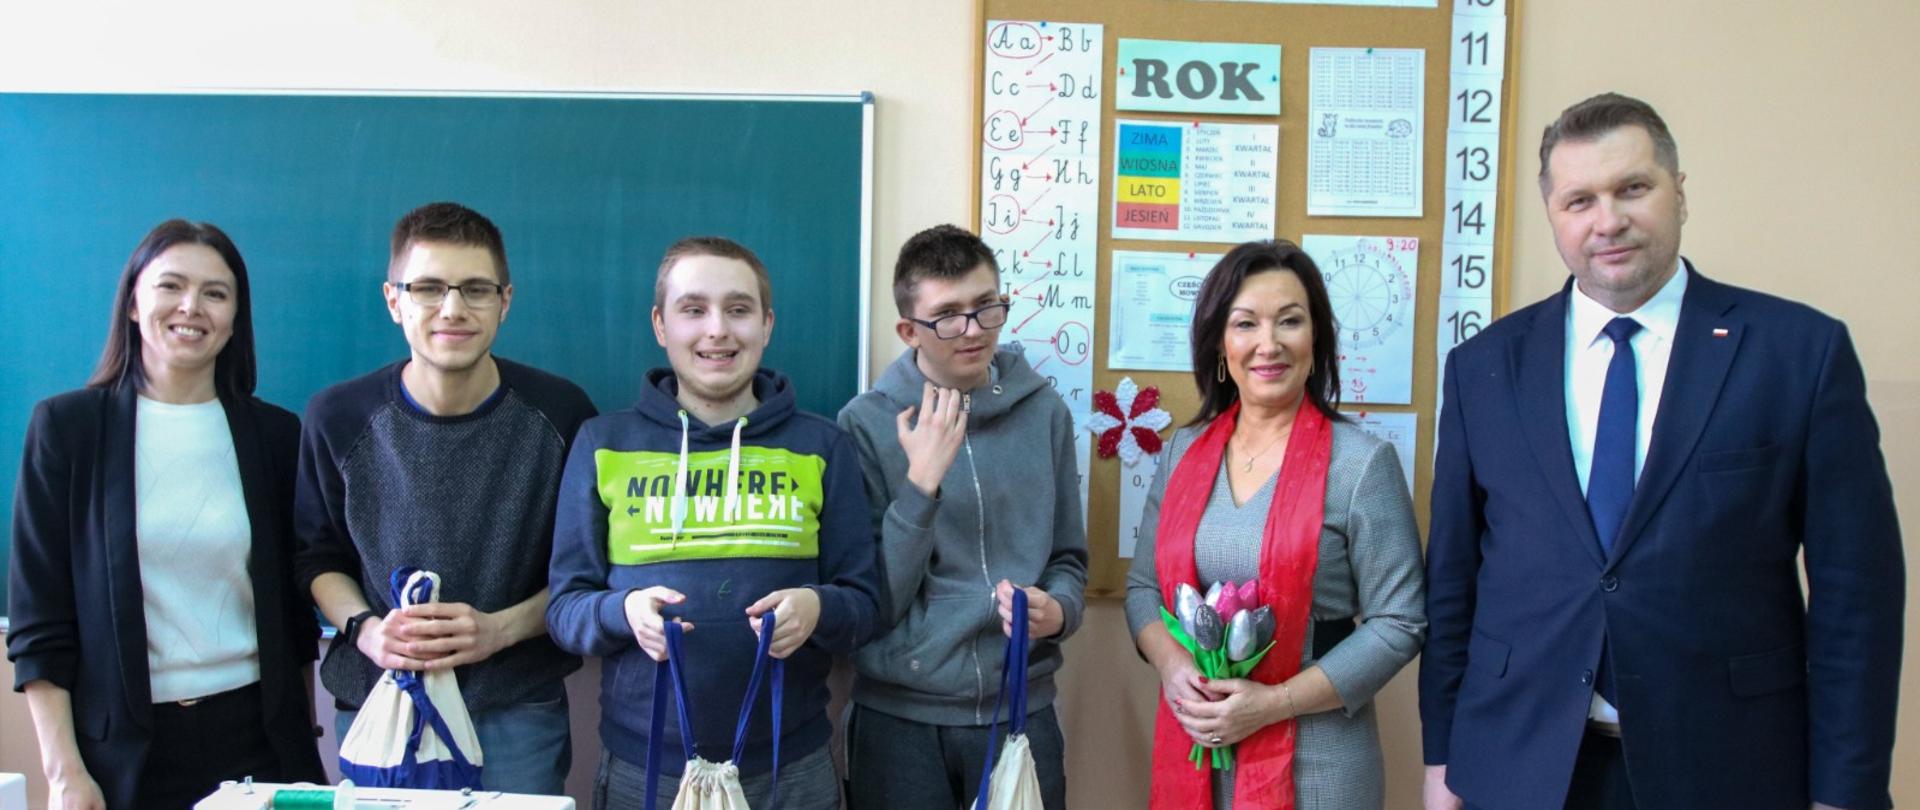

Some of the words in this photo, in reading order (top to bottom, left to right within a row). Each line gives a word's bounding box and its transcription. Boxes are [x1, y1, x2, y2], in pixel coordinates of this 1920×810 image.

[1461, 31, 1488, 66] 11
[1131, 58, 1265, 101] ROK
[1457, 89, 1492, 123] 12
[1131, 131, 1168, 146] ZIMA
[1120, 157, 1178, 172] WIOSNA
[1456, 147, 1490, 181] 13
[1130, 183, 1166, 198] LATO
[1125, 207, 1169, 223] JESIEŃ
[1452, 200, 1485, 235] 14
[1354, 253, 1366, 263] 12
[1388, 274, 1395, 283] 2
[1451, 254, 1485, 288] 15
[1392, 294, 1399, 304] 3
[1447, 310, 1481, 344] 16
